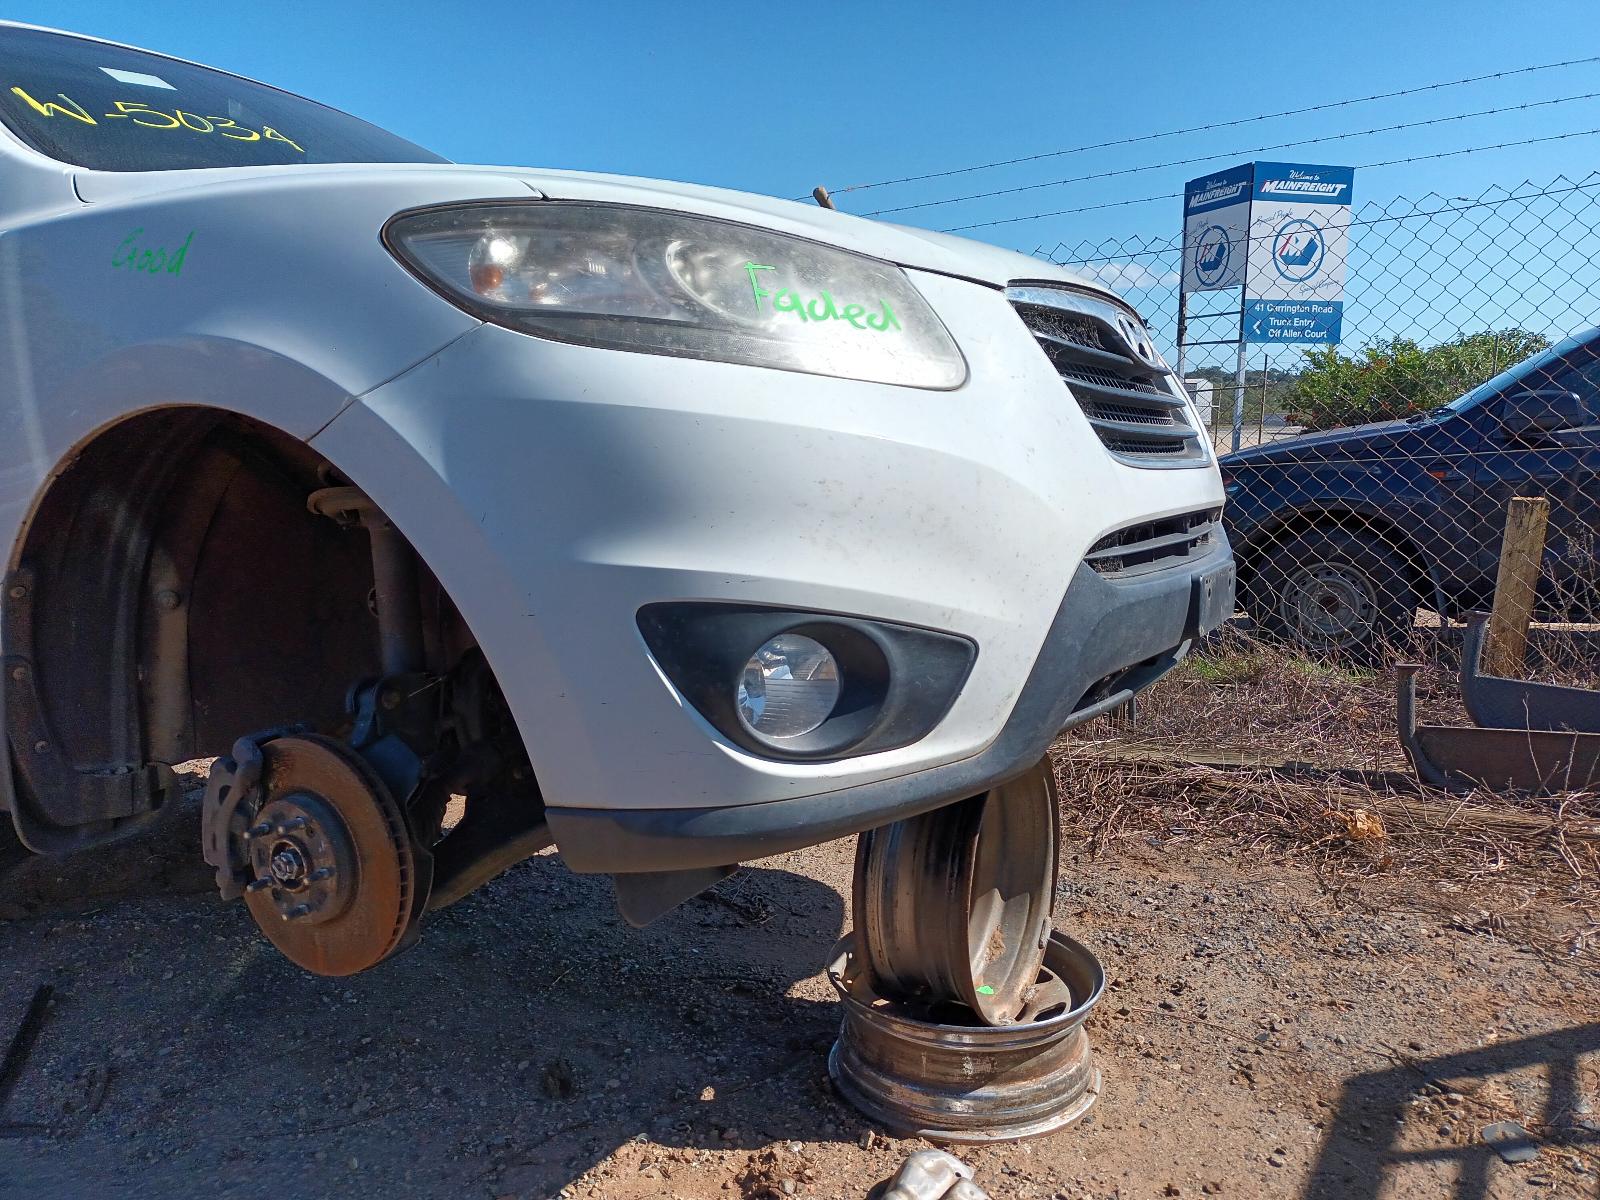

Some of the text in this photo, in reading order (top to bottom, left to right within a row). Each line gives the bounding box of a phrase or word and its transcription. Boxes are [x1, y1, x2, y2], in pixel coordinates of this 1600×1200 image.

[1289, 169, 1320, 181] Welcome to
[1188, 181, 1247, 209] MAINFREIGHT
[1260, 179, 1348, 197] MAINFREIGHT
[111, 227, 196, 277] Good
[744, 261, 901, 331] Faded
[1254, 303, 1333, 314] 41 Carrington Road
[1269, 317, 1316, 328] Truck Entry
[1268, 329, 1328, 339] Off Allen Court
